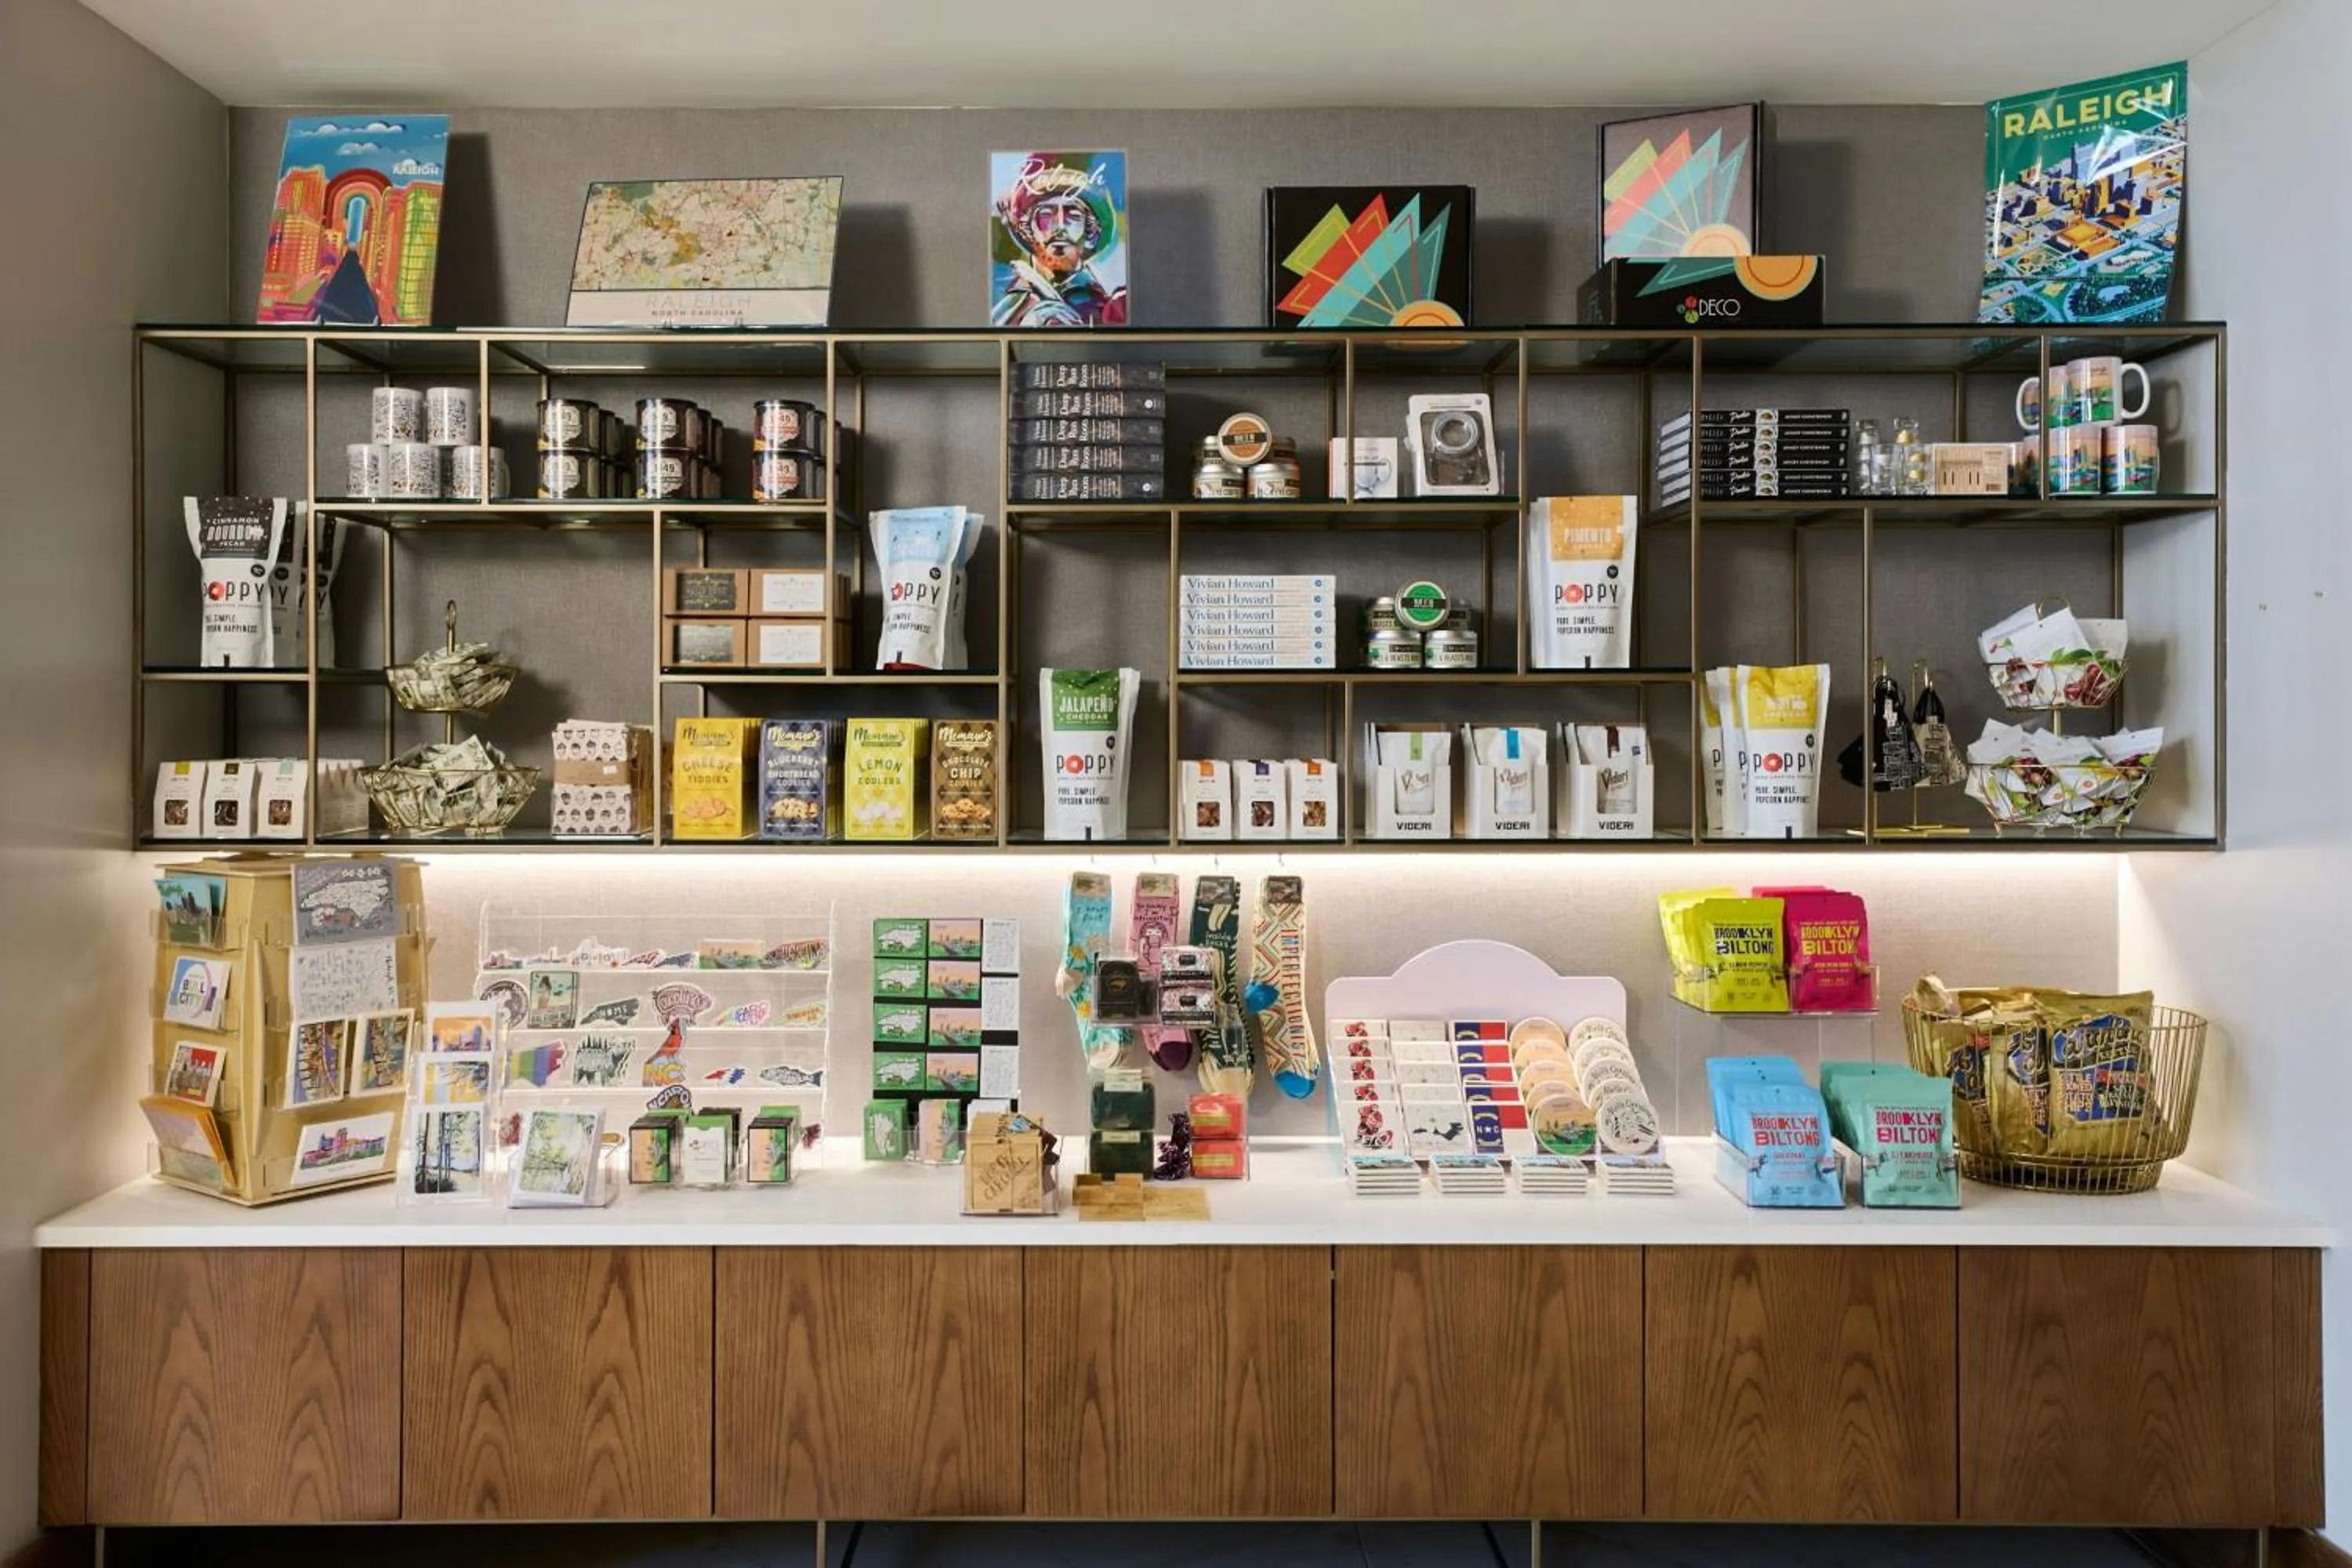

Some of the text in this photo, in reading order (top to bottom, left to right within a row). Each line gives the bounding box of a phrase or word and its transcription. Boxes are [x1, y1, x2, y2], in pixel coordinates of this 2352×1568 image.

[2004, 81, 2173, 138] RALEIGH
[1699, 299, 1741, 316] DECO
[1187, 579, 1274, 588] Vivian Howard
[1187, 593, 1274, 604] Vivian Howard
[1187, 609, 1274, 619] Vivian Howard
[1187, 625, 1274, 634] Vivian Howard
[1187, 640, 1274, 650] Vivian Howard
[1187, 655, 1274, 666] Vivian Howard
[858, 759, 902, 774] LEMON
[951, 768, 982, 779] CHIP
[1496, 822, 1530, 830] VIDERI
[1599, 822, 1635, 830] VIDERI
[1715, 927, 1773, 938] BROOKLYN
[1802, 926, 1859, 938] BROOKLYN
[1715, 940, 1774, 954] BILTONG
[1281, 928, 1305, 1058] IMPERFECTIONIST
[644, 1062, 685, 1087] NC
[1753, 1117, 1818, 1130] BROOKLYN
[1876, 1112, 1942, 1125] BROOKLYN
[1755, 1131, 1820, 1146] BILTONG
